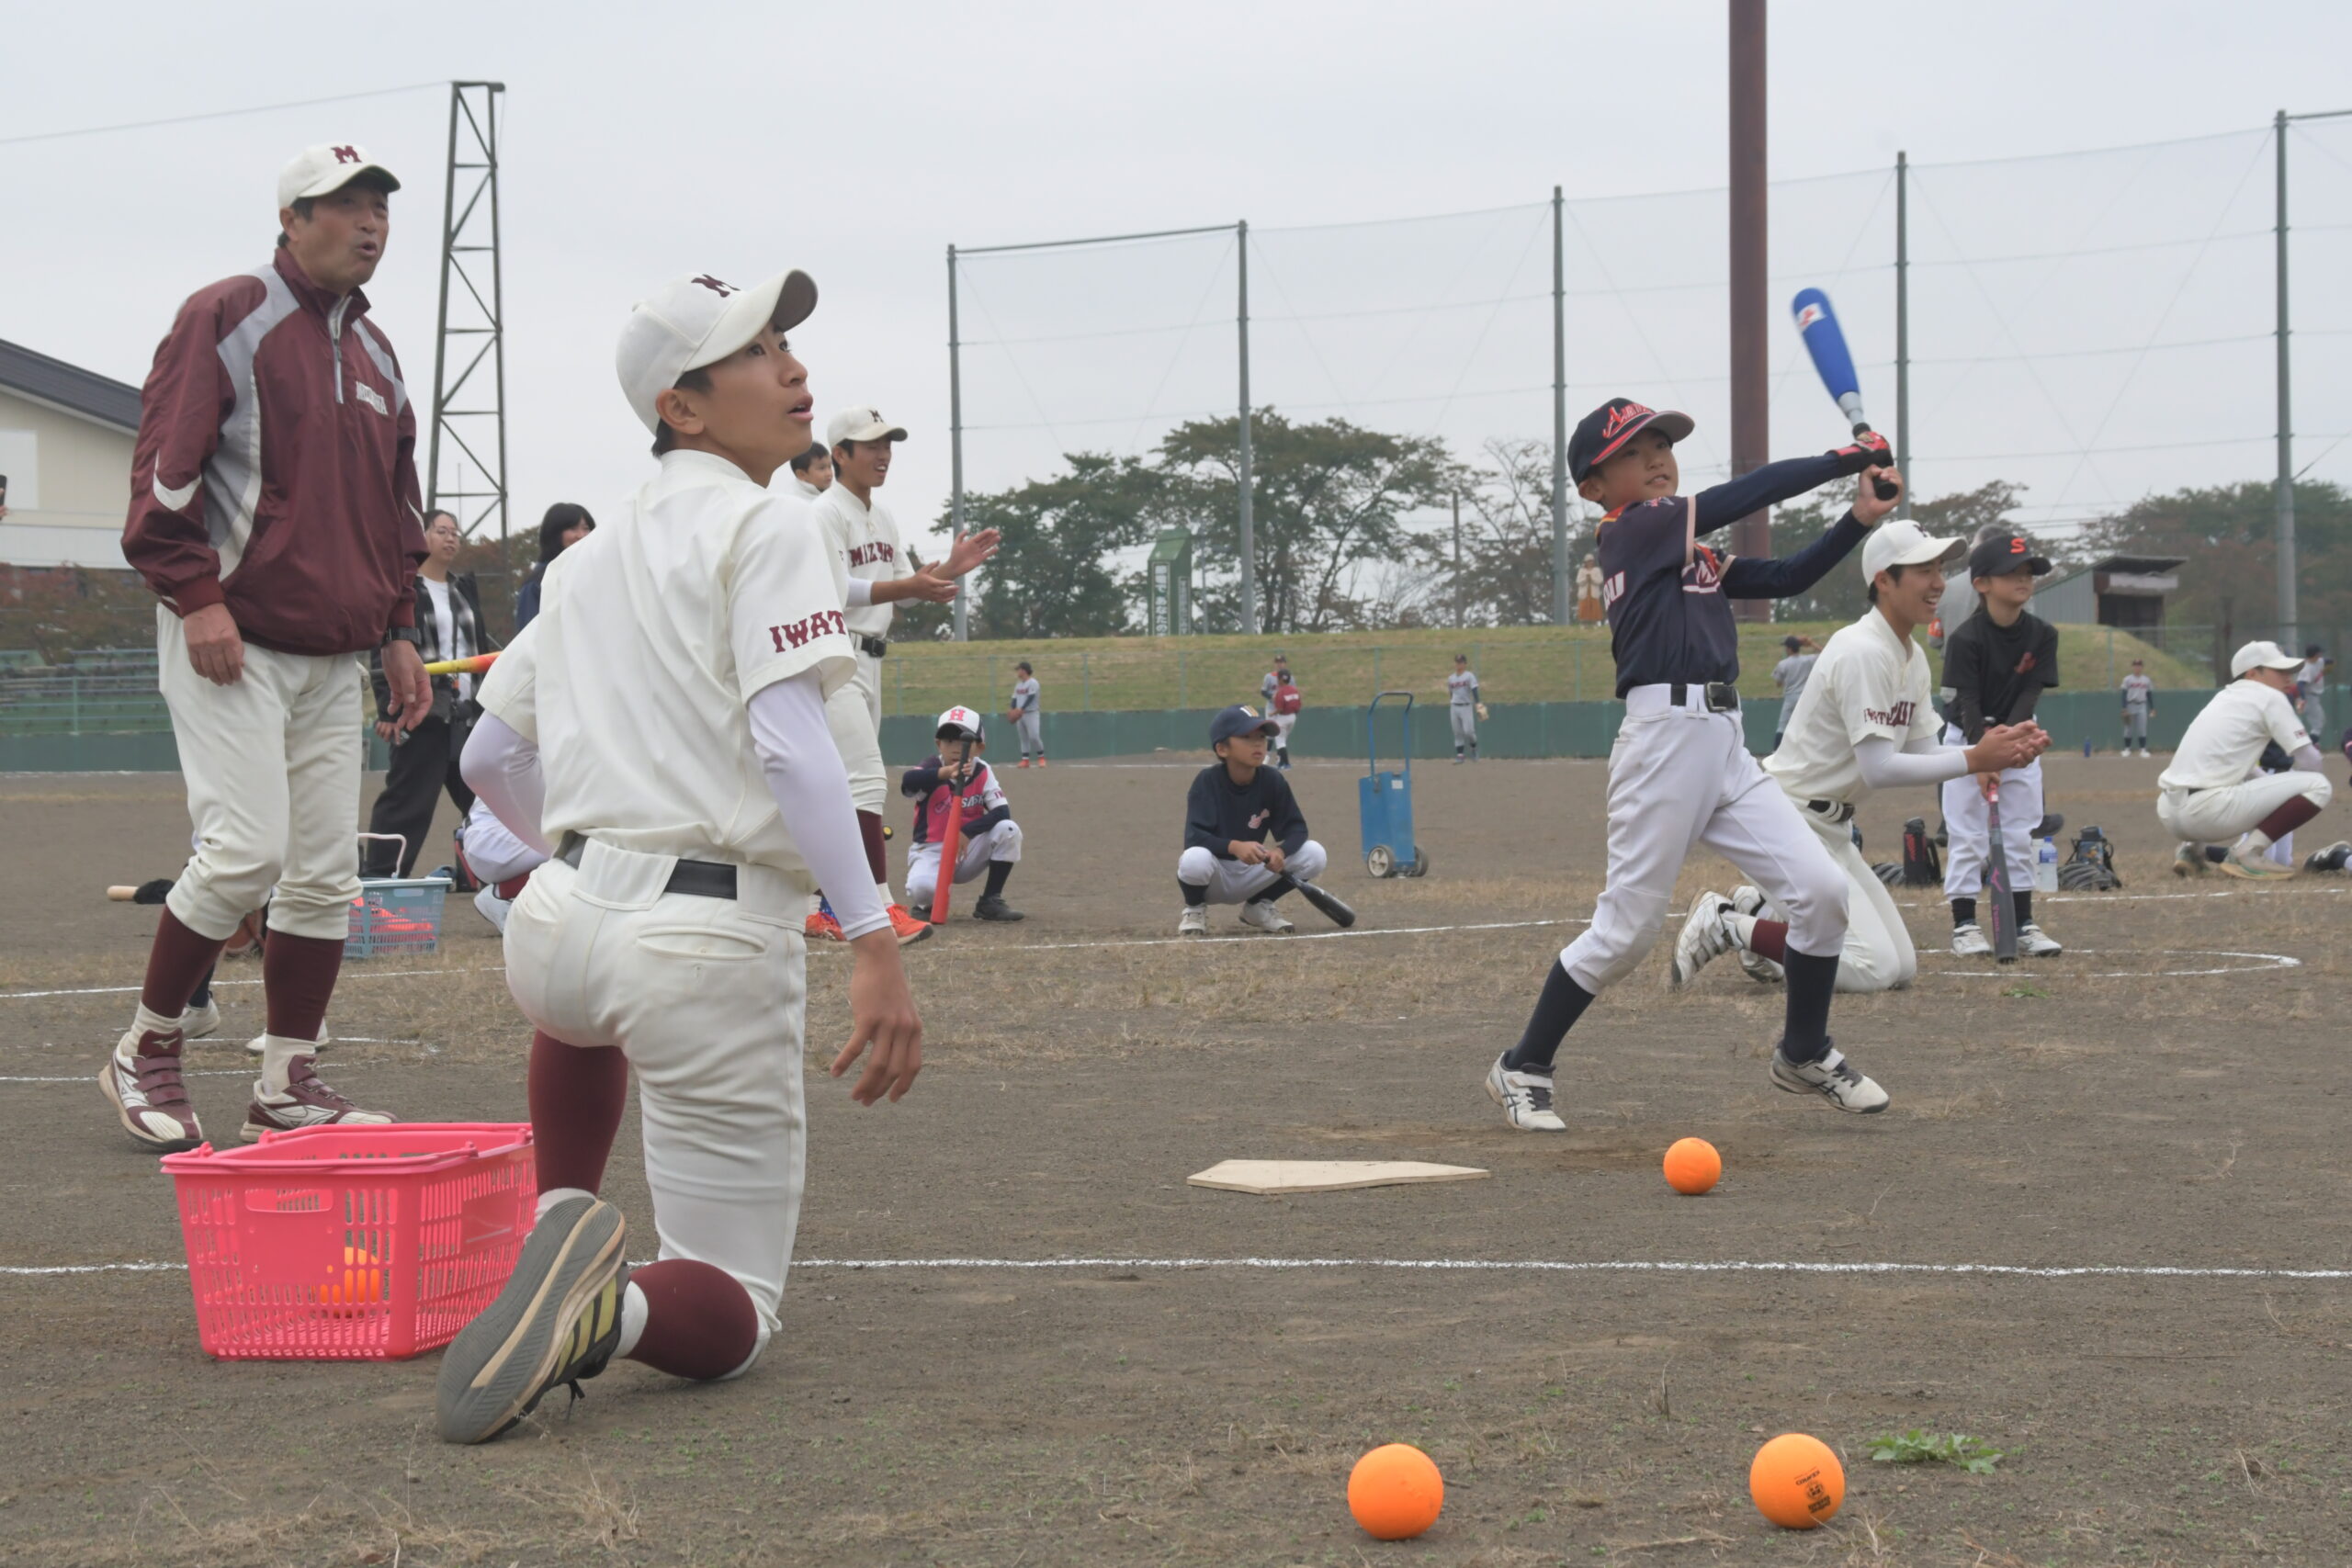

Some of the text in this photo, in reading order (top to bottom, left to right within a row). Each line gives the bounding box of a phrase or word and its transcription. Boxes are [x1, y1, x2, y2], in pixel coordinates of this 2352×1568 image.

[330, 145, 363, 164] M
[2009, 537, 2027, 554] S
[948, 708, 966, 721] H
